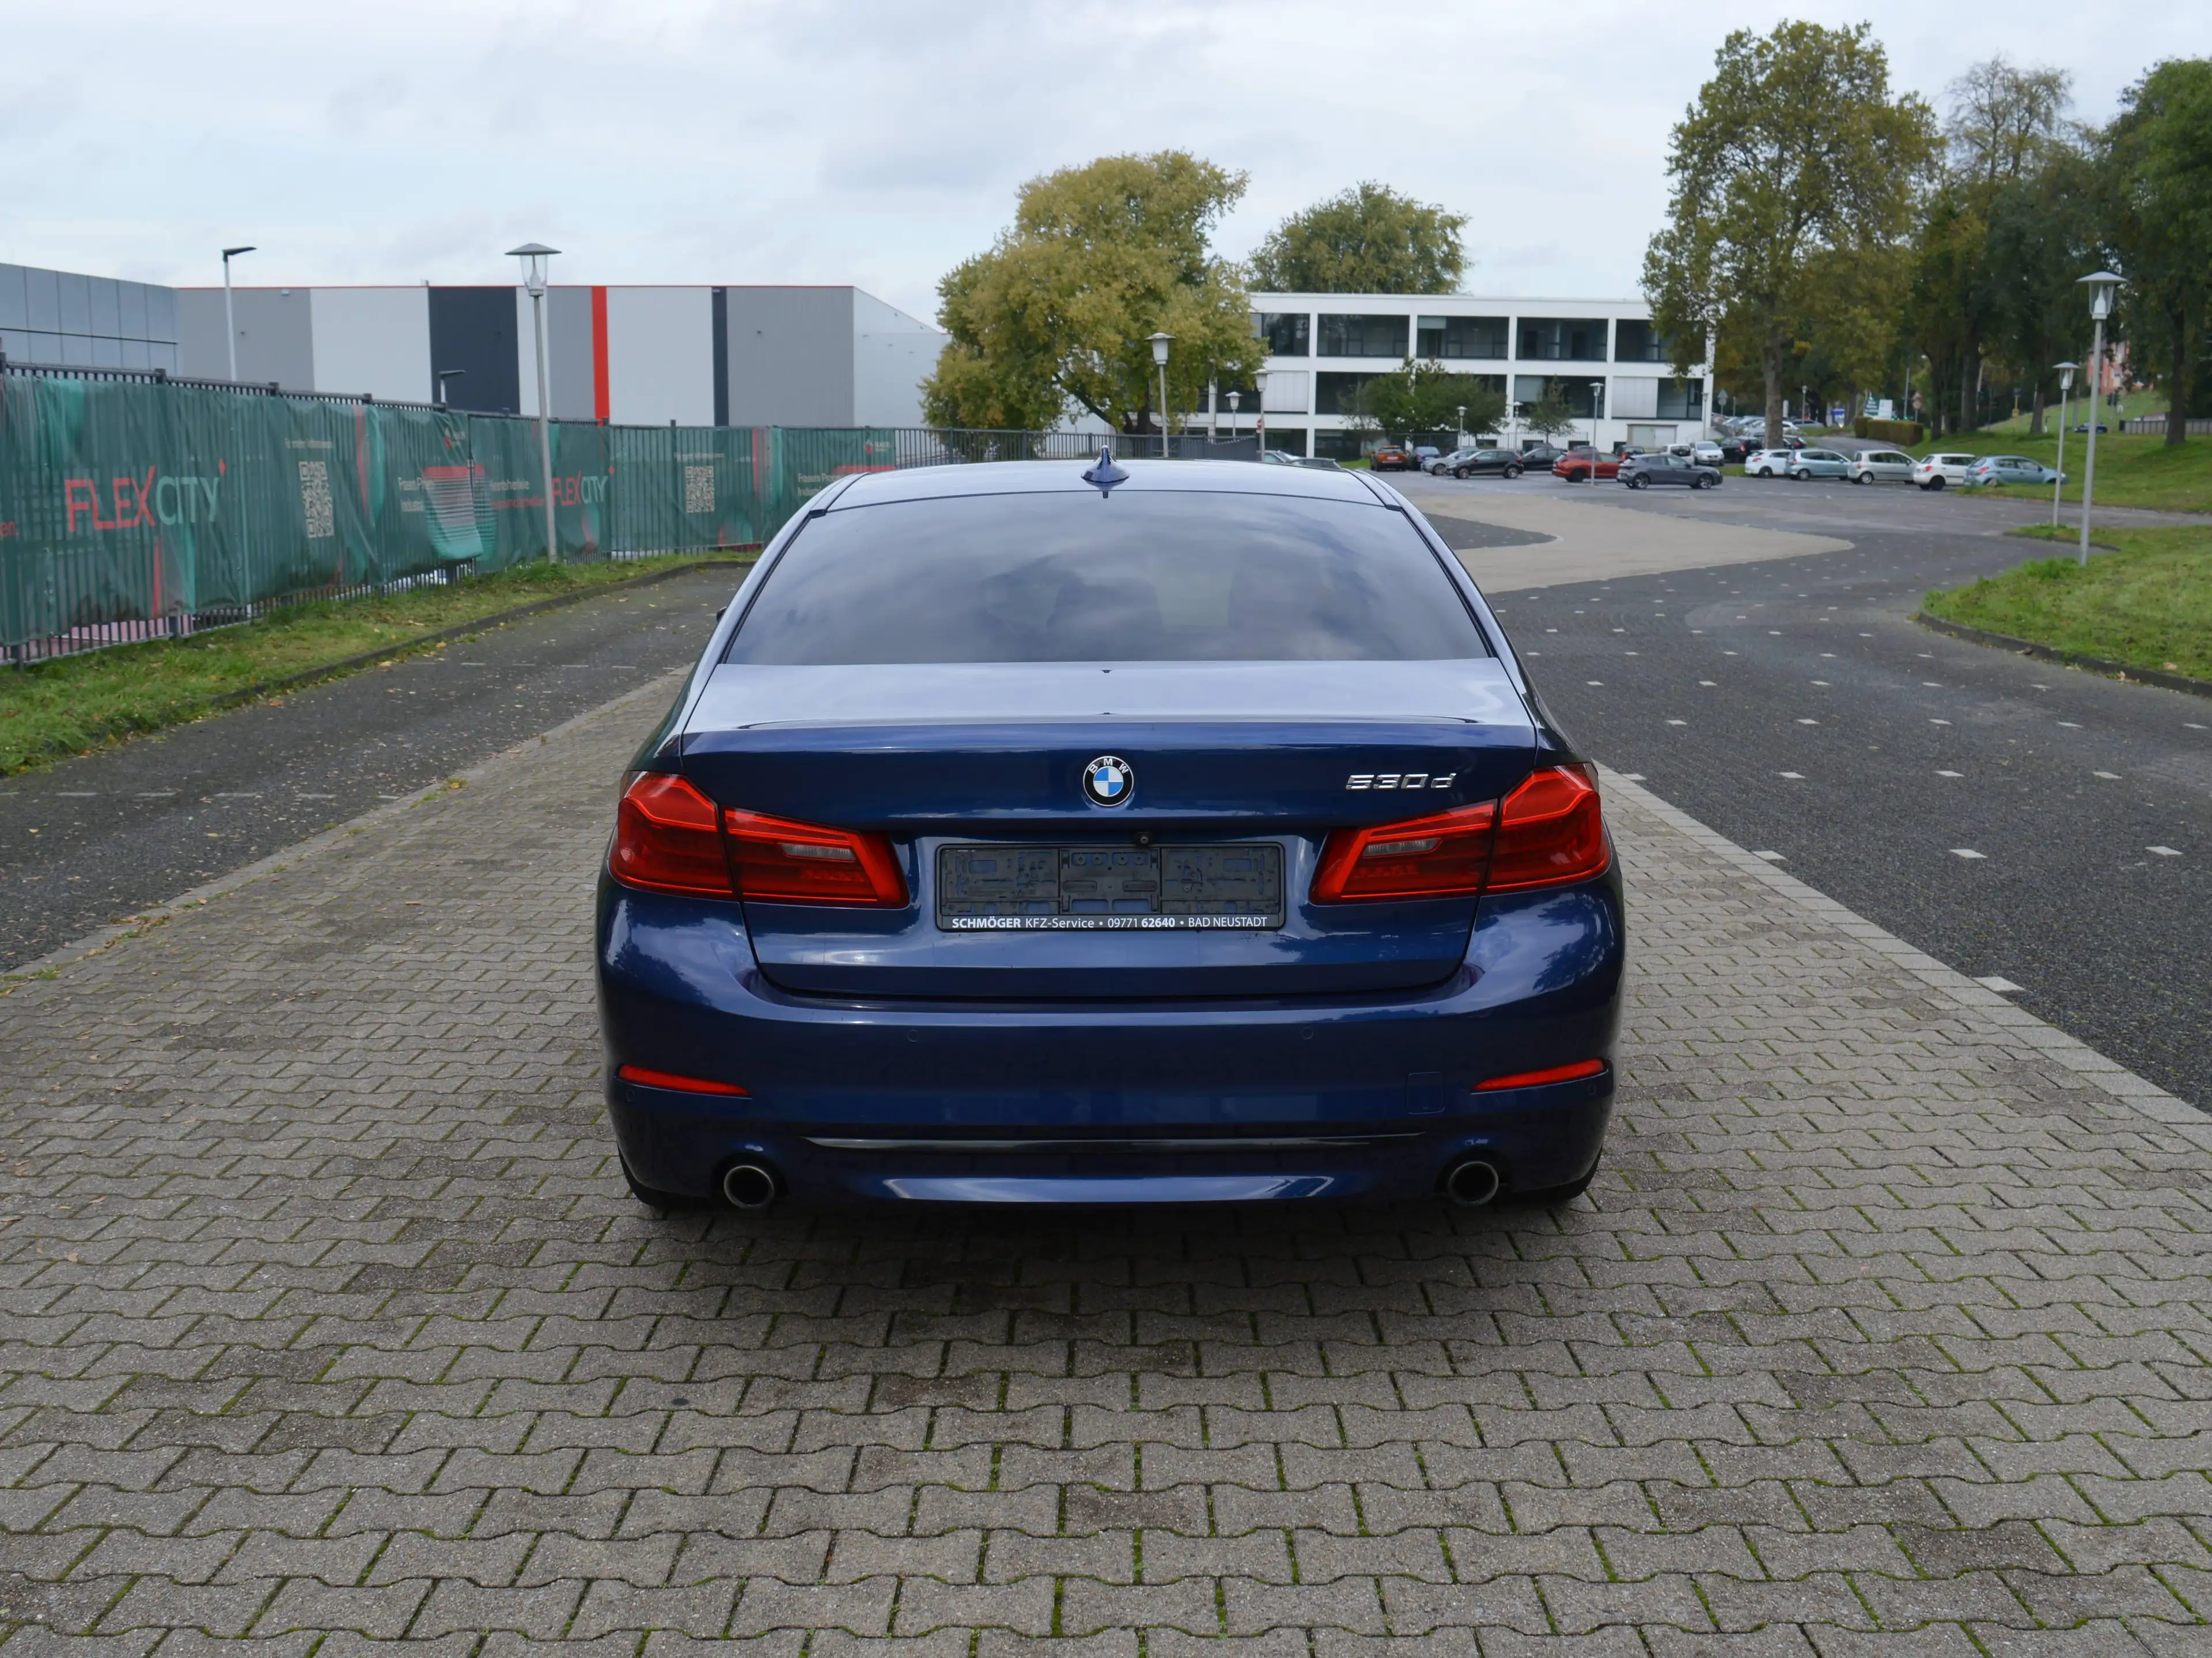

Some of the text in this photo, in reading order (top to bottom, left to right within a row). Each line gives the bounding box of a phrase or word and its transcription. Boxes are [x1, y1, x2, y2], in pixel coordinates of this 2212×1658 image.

[65, 465, 219, 533] FLEXCITY
[1088, 758, 1129, 774] BMW
[1346, 773, 1457, 790] 530d
[952, 916, 1267, 928] SCHMÖGER KFZ-Service 09771 62640 BAD NEUSTADT
